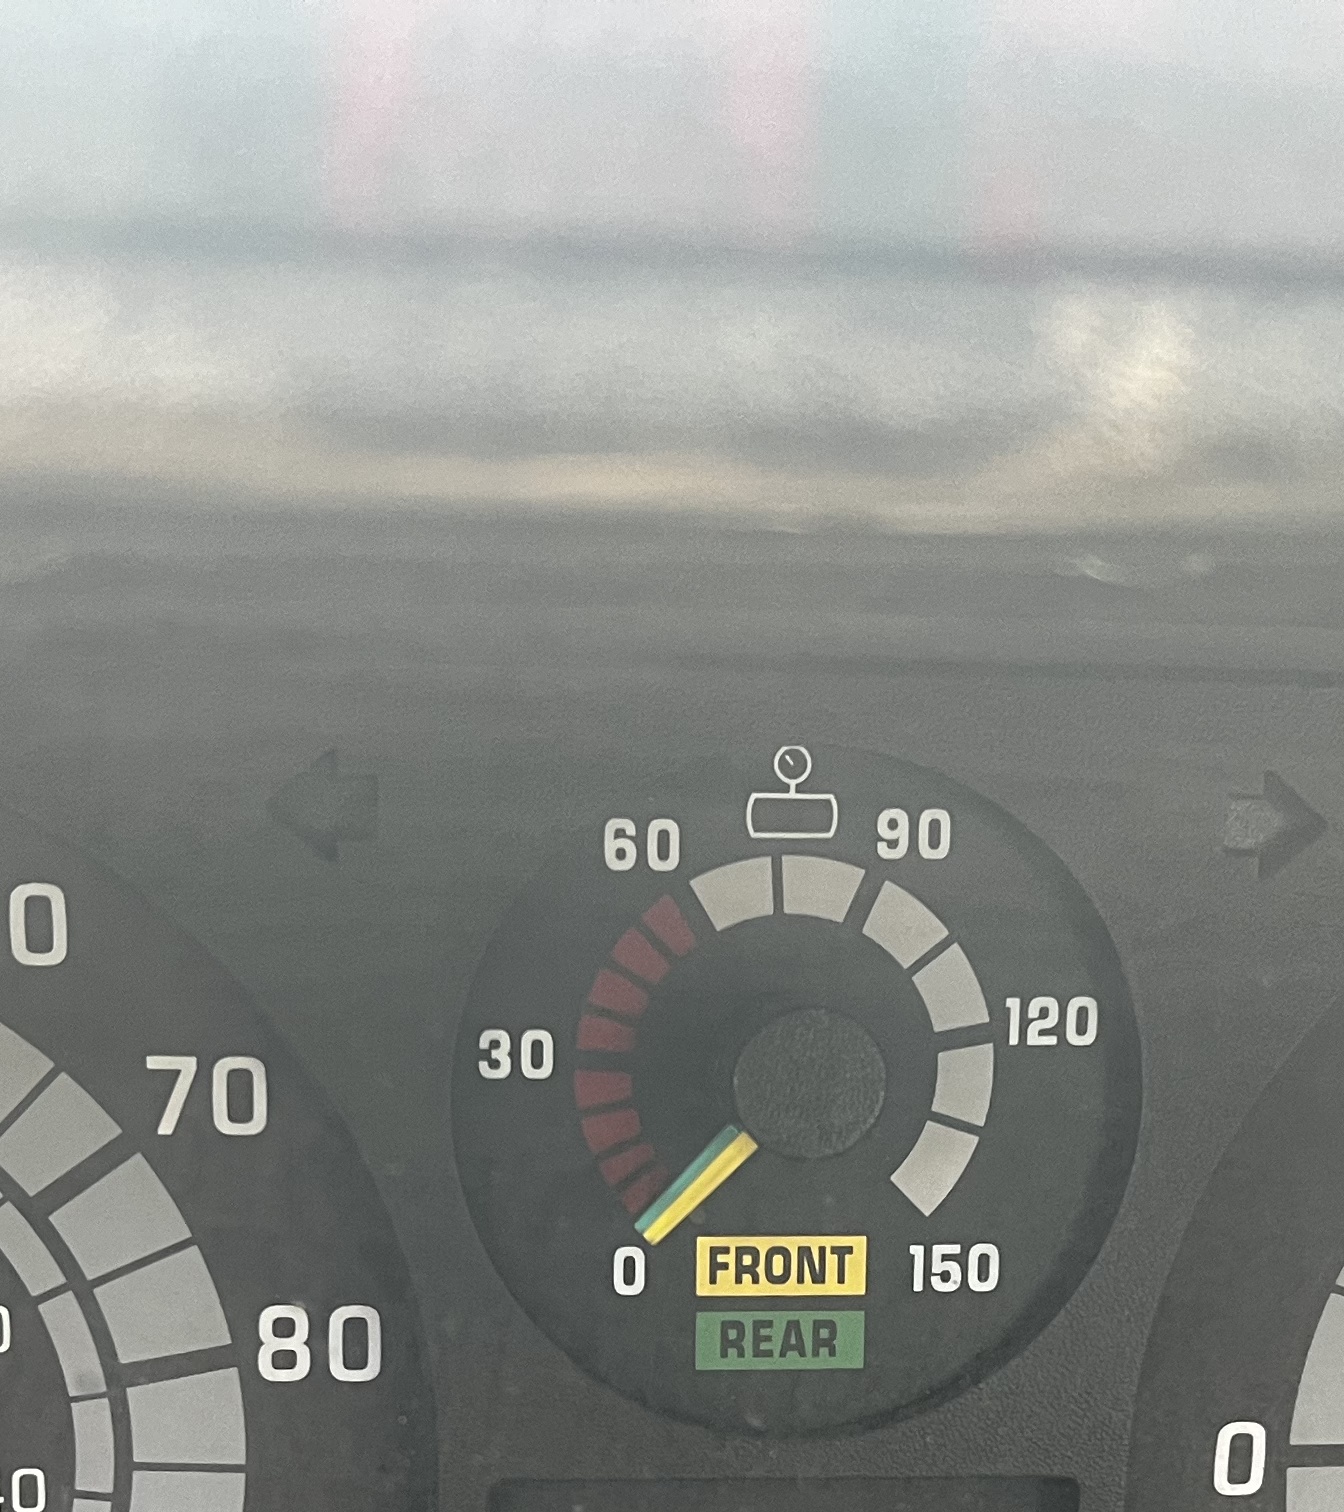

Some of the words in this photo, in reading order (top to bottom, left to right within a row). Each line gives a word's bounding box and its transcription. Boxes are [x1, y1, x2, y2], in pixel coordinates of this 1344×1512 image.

[603, 818, 681, 872] 60
[875, 808, 952, 860] 90
[1005, 996, 1099, 1047] 120
[477, 1029, 554, 1080] 30
[145, 1055, 268, 1136] 70
[612, 1246, 647, 1295] 0
[707, 1245, 855, 1286] FRONT
[908, 1243, 1000, 1293] 150
[257, 1304, 382, 1382] 80
[718, 1319, 838, 1359] REAR
[1212, 1421, 1267, 1496] 0
